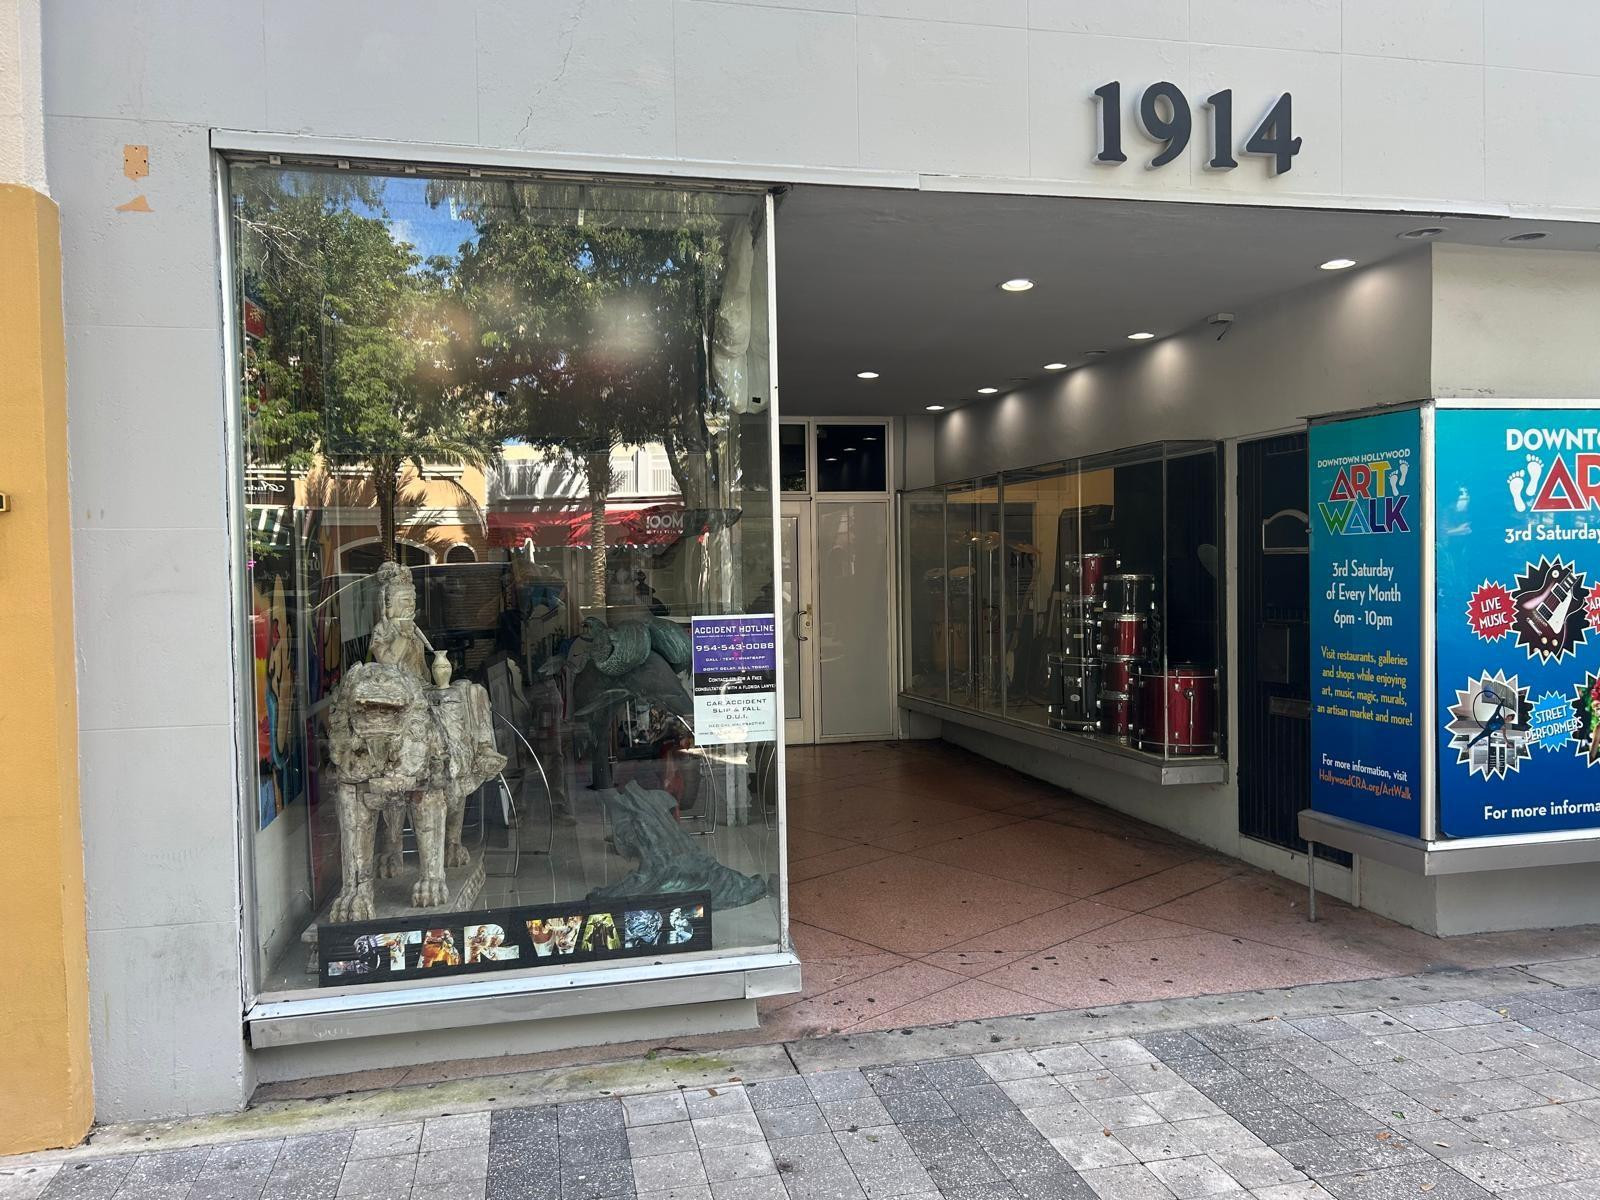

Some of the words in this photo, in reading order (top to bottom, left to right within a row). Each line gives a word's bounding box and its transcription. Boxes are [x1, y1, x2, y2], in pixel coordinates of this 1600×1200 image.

[1093, 81, 1302, 175] 1914
[1506, 428, 1600, 451] DOWNT
[1317, 456, 1360, 468] DOWNTOWN
[1361, 448, 1411, 463] HOLLYWOOD
[1328, 461, 1392, 502] ART
[1317, 495, 1411, 536] WALK
[1504, 524, 1532, 544] 3rd
[1332, 559, 1348, 577] 3rd
[1351, 558, 1394, 581] Saturday
[1326, 582, 1336, 600] of
[1338, 583, 1365, 606] Every
[1368, 583, 1401, 602] Month
[1481, 597, 1502, 613] LIVE
[694, 625, 737, 635] ACCIDENT
[738, 624, 775, 633] HOTLINE
[1333, 609, 1355, 629] 6pm
[1364, 610, 1393, 630] 10pm
[1479, 612, 1508, 629] MUSIC
[695, 642, 774, 652] 954-543-0088
[1321, 645, 1336, 660] Visit
[1337, 650, 1377, 664] restaurants,
[1378, 650, 1408, 667] galleries
[1322, 665, 1334, 678] and
[1335, 665, 1355, 683] shops
[1356, 667, 1374, 682] while
[1376, 672, 1407, 689] enjoying
[725, 698, 767, 706] ACCIDENT
[1321, 686, 1333, 697] art,
[1334, 688, 1355, 699] music,
[1356, 690, 1379, 704] magic,
[1380, 690, 1407, 707] murals,
[1316, 705, 1325, 713] an
[1326, 705, 1348, 717] artisan
[1349, 706, 1374, 721] market
[1375, 708, 1389, 722] and
[1390, 712, 1413, 726] more!
[1535, 705, 1568, 724] STREET
[1524, 717, 1584, 743] PERFORMERS
[1322, 753, 1333, 766] For
[1334, 760, 1351, 770] more
[1352, 760, 1391, 780] information,
[1393, 769, 1408, 782] visit
[1318, 768, 1412, 800] HollywoodCRA.org/ArtWalk
[1484, 805, 1507, 820] For
[1511, 806, 1547, 818] more
[328, 923, 520, 977] STAR
[525, 904, 704, 957] WARS
